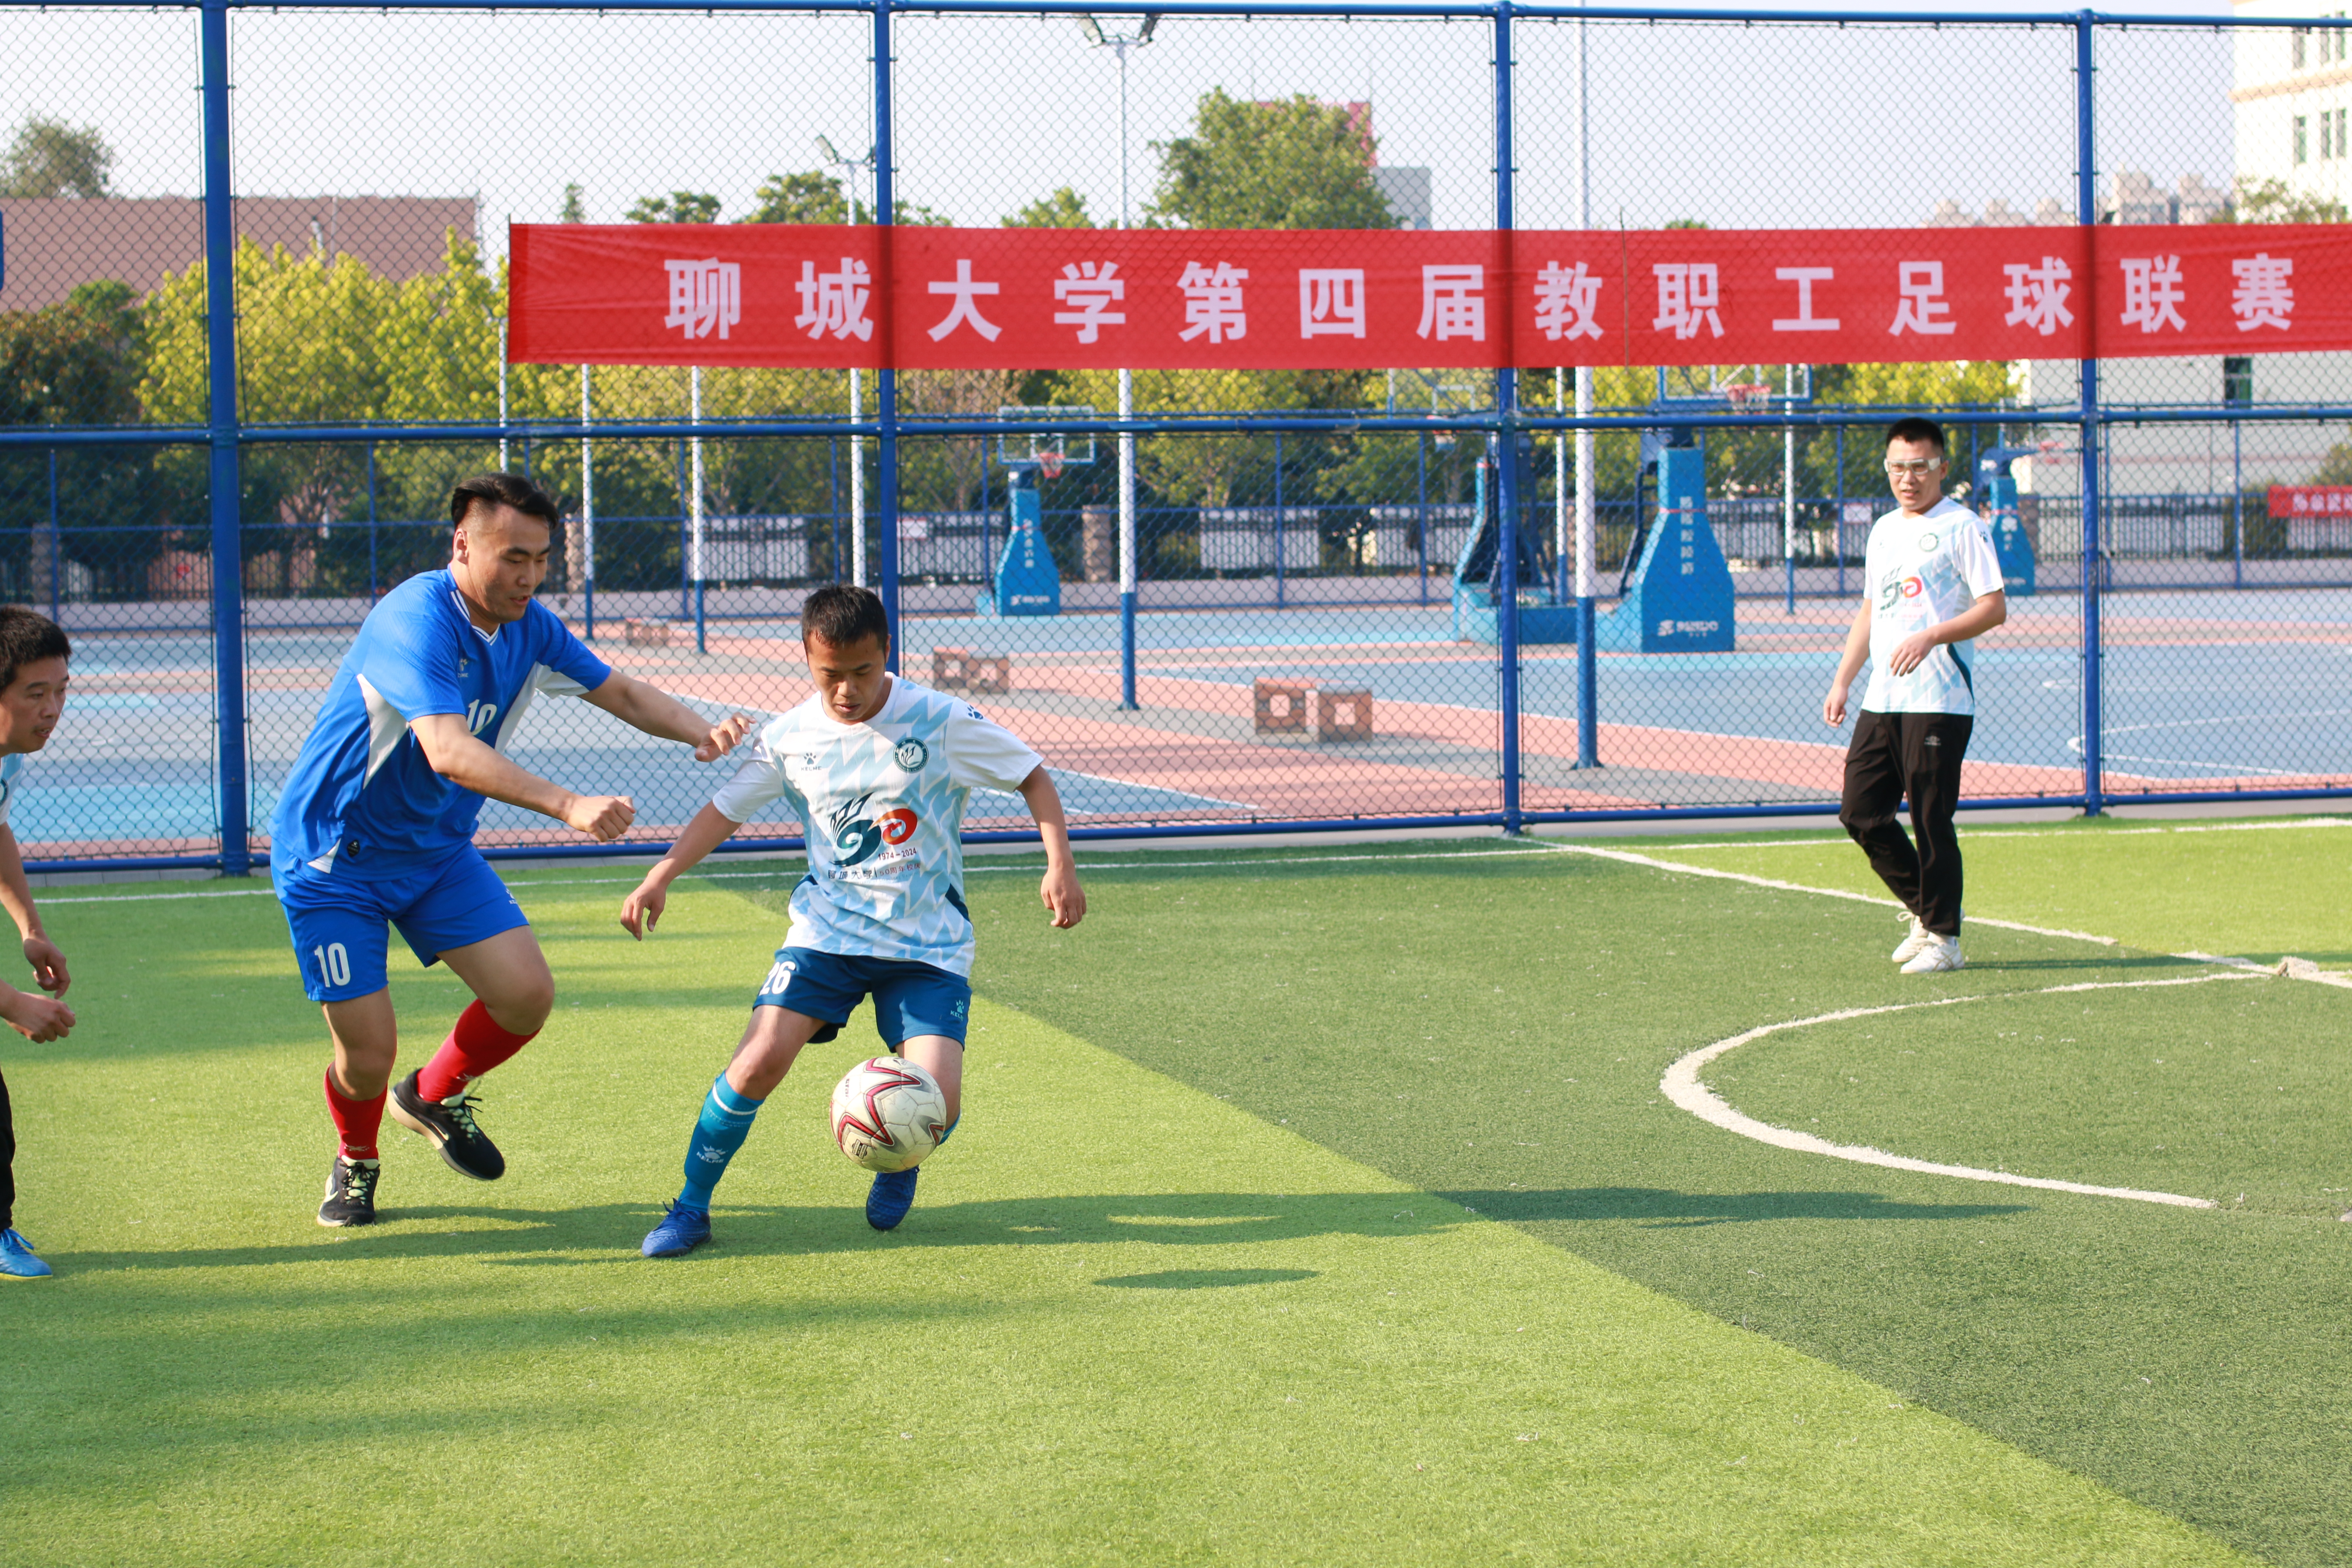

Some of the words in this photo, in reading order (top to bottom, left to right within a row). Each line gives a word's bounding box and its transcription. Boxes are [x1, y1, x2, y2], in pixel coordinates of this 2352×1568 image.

[664, 252, 2295, 344] 聊城大学第四届教职工足球联赛
[466, 699, 497, 735] 10
[314, 942, 351, 988] 10
[759, 961, 796, 996] 26
[696, 1151, 724, 1164] KELME
